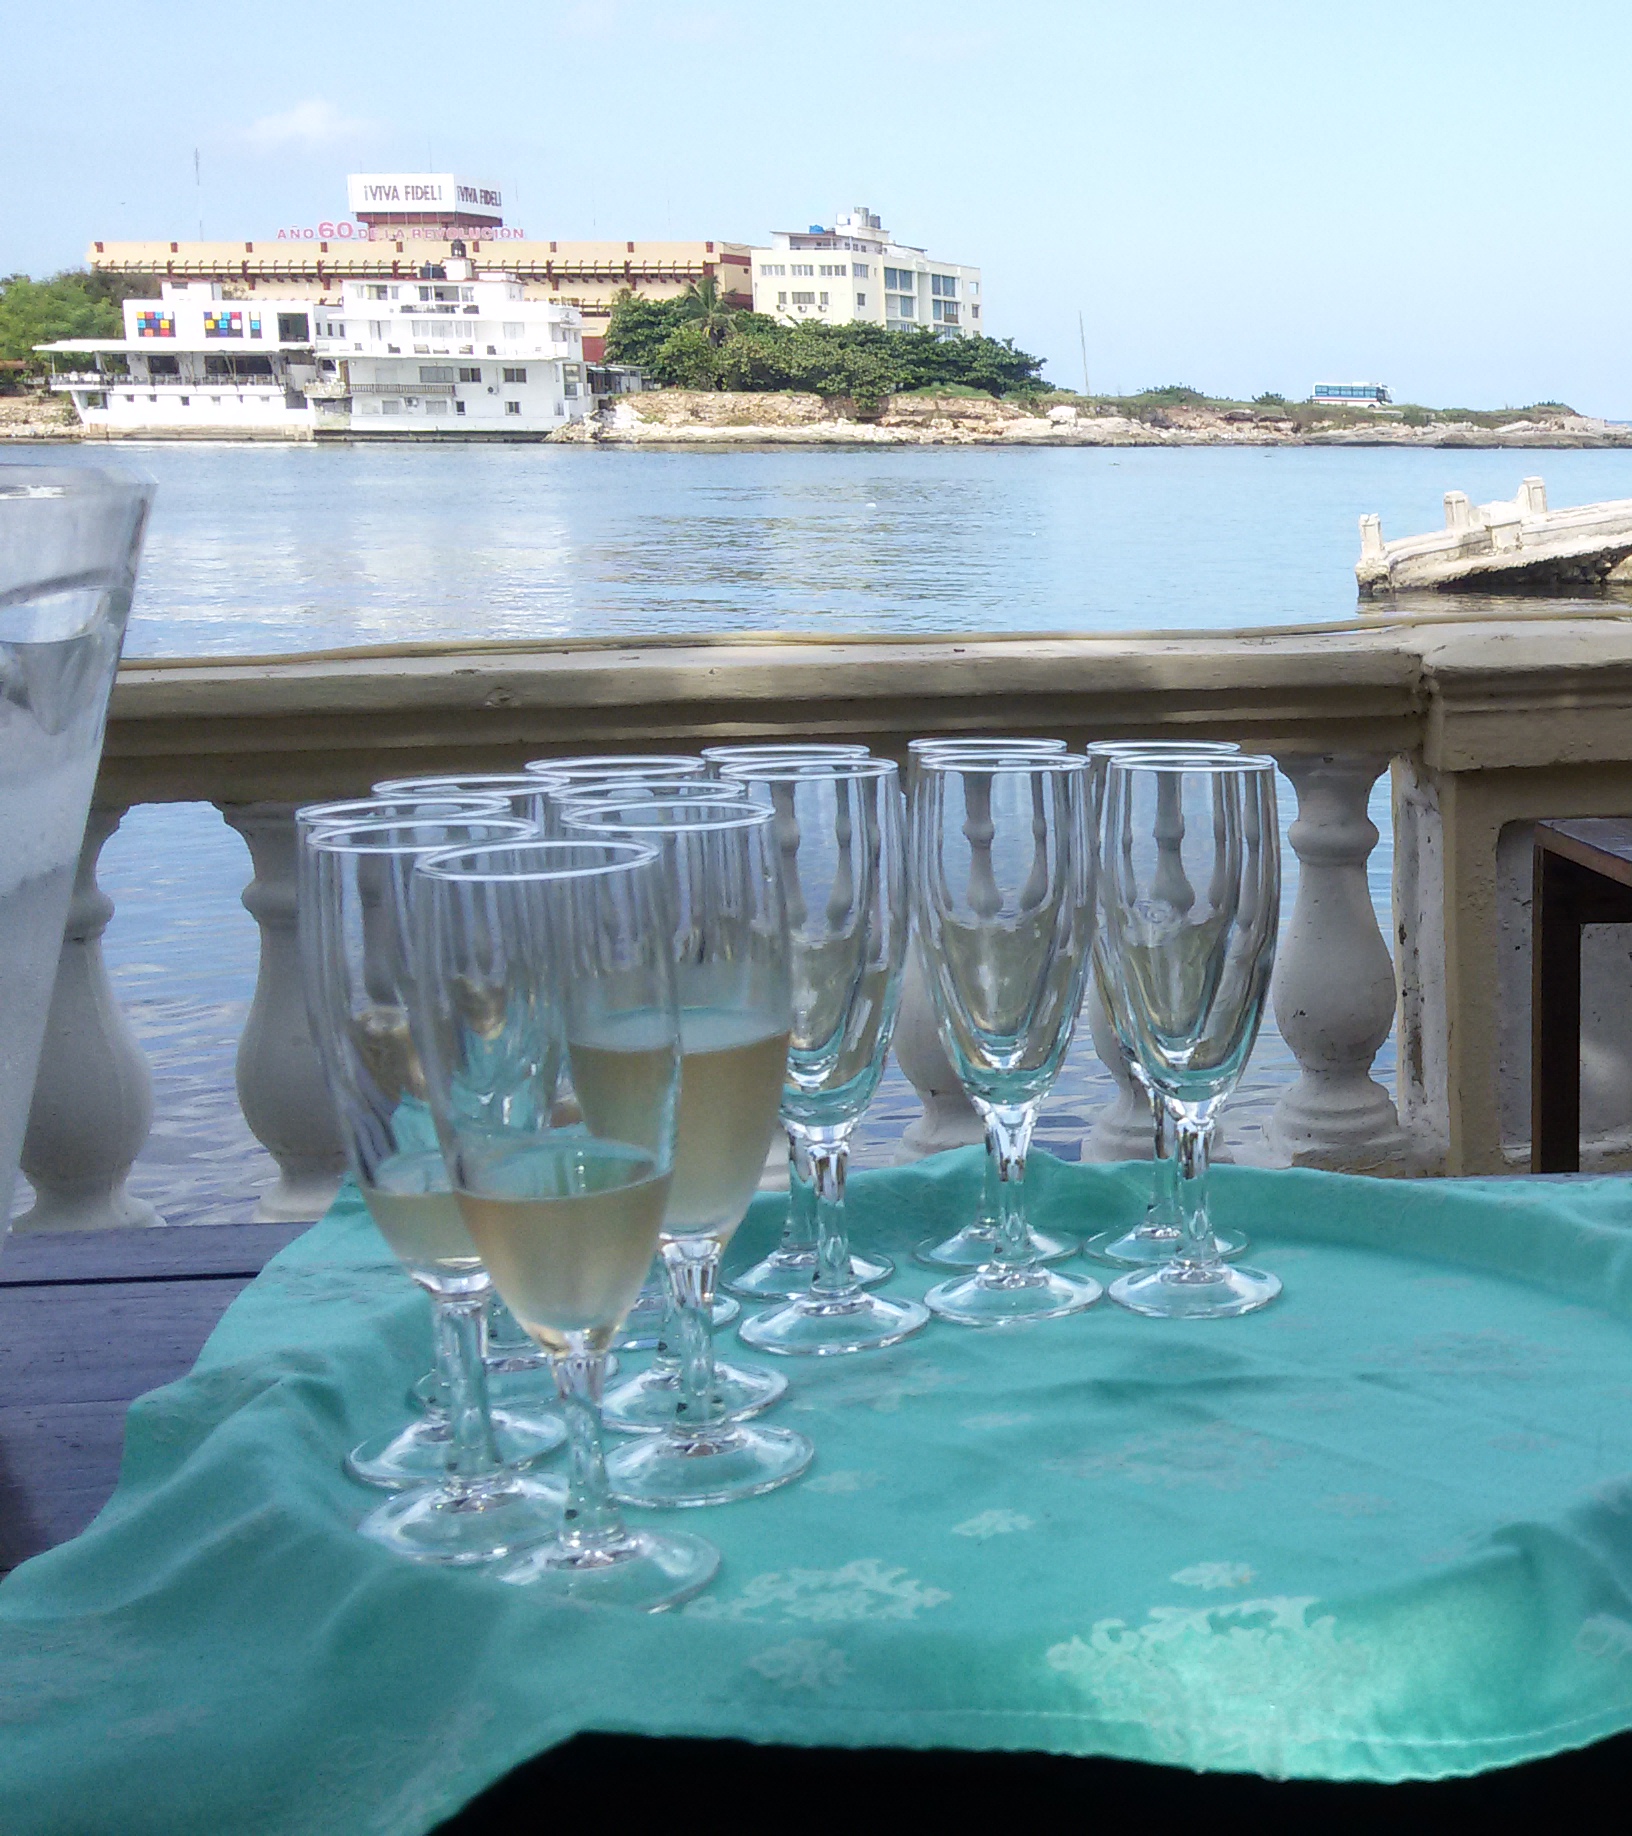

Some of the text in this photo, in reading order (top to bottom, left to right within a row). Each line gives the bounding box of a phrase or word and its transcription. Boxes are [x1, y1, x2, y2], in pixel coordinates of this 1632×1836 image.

[404, 184, 443, 202] FIDEL!
[277, 224, 314, 239] AÑO
[318, 221, 354, 239] 60
[358, 228, 377, 240] DE
